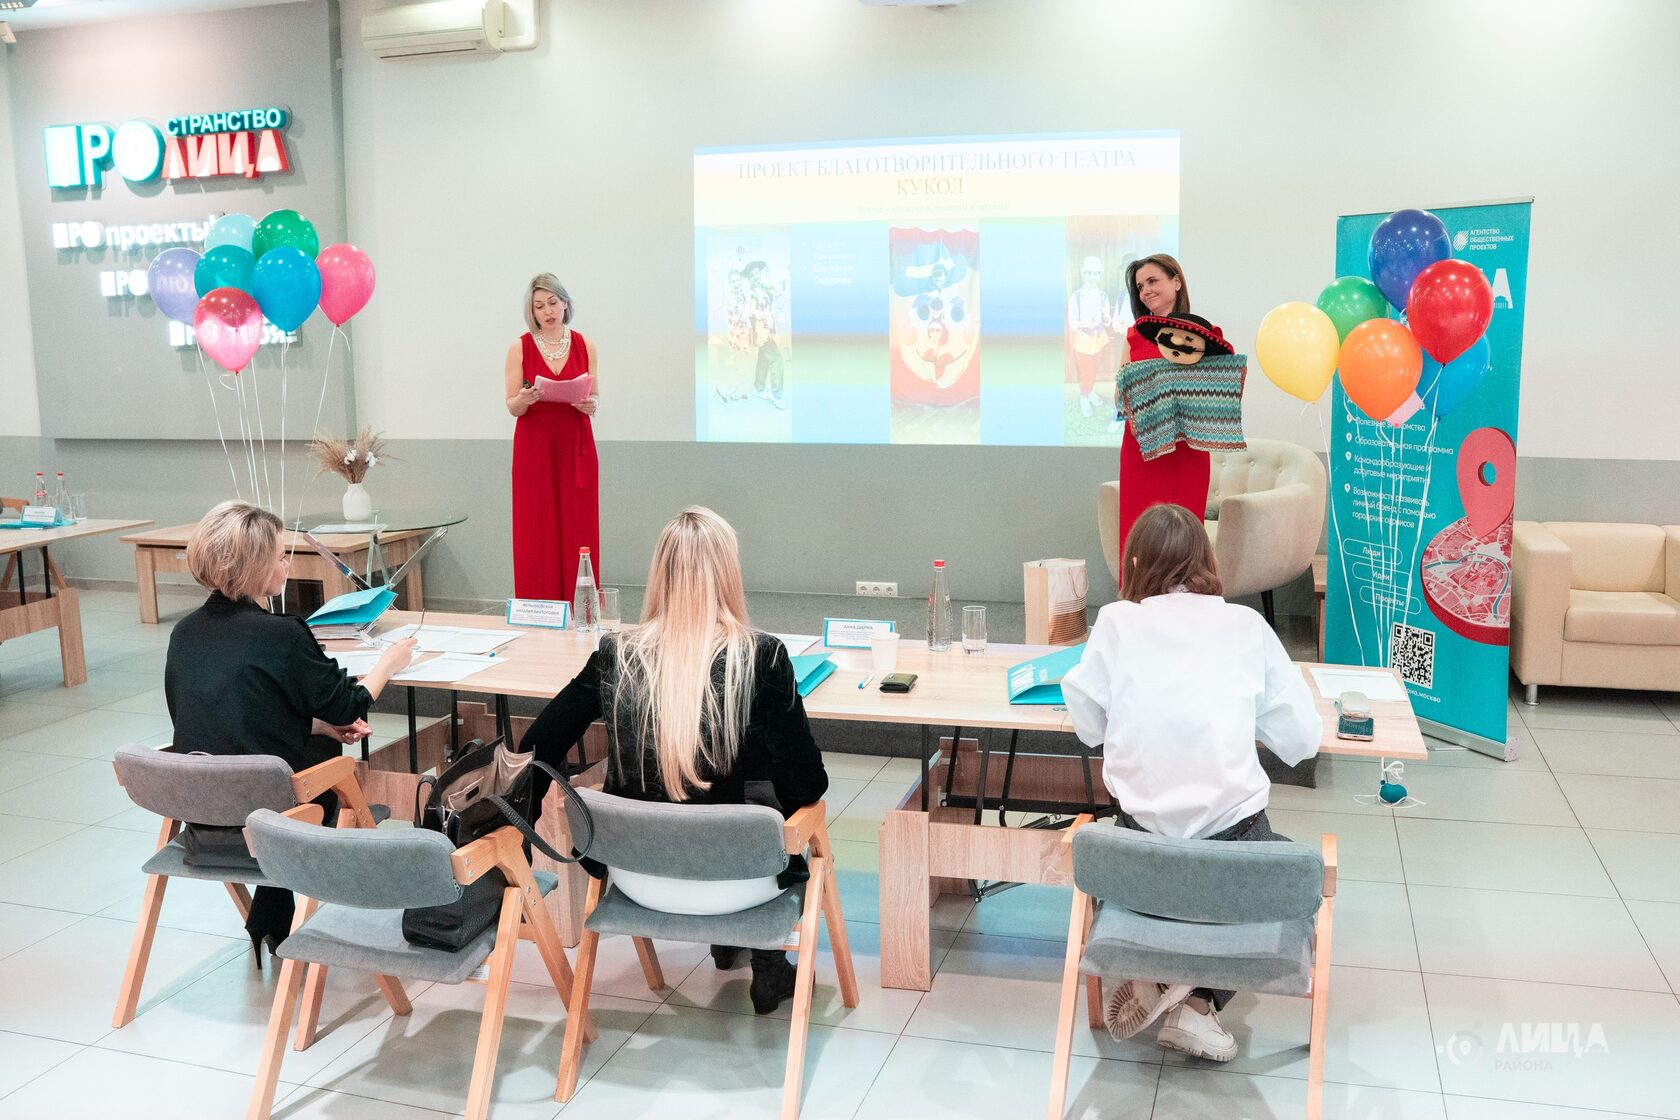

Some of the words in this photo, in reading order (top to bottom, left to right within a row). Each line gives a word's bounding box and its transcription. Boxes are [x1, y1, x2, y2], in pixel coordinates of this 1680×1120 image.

[165, 106, 289, 137] СТРАНСТВО
[43, 119, 165, 187] ПРО
[161, 129, 290, 180] ЛИЦА
[738, 160, 815, 180] ПРОЕКТ
[816, 152, 1054, 177] БЛАГОТВОРИТЕЛЬНОГО
[1058, 149, 1137, 169] ТЕАТРА
[895, 177, 965, 196] КУКОЛ
[1470, 228, 1500, 236] АГЕНТСТВО
[1469, 235, 1514, 243] ОБЩЕСТВЕННЫХ
[1469, 243, 1497, 251] ПРОЕКТОВ
[1395, 495, 1430, 507] развиваь
[1362, 546, 1381, 557] Люди
[1373, 571, 1390, 581] Идеи
